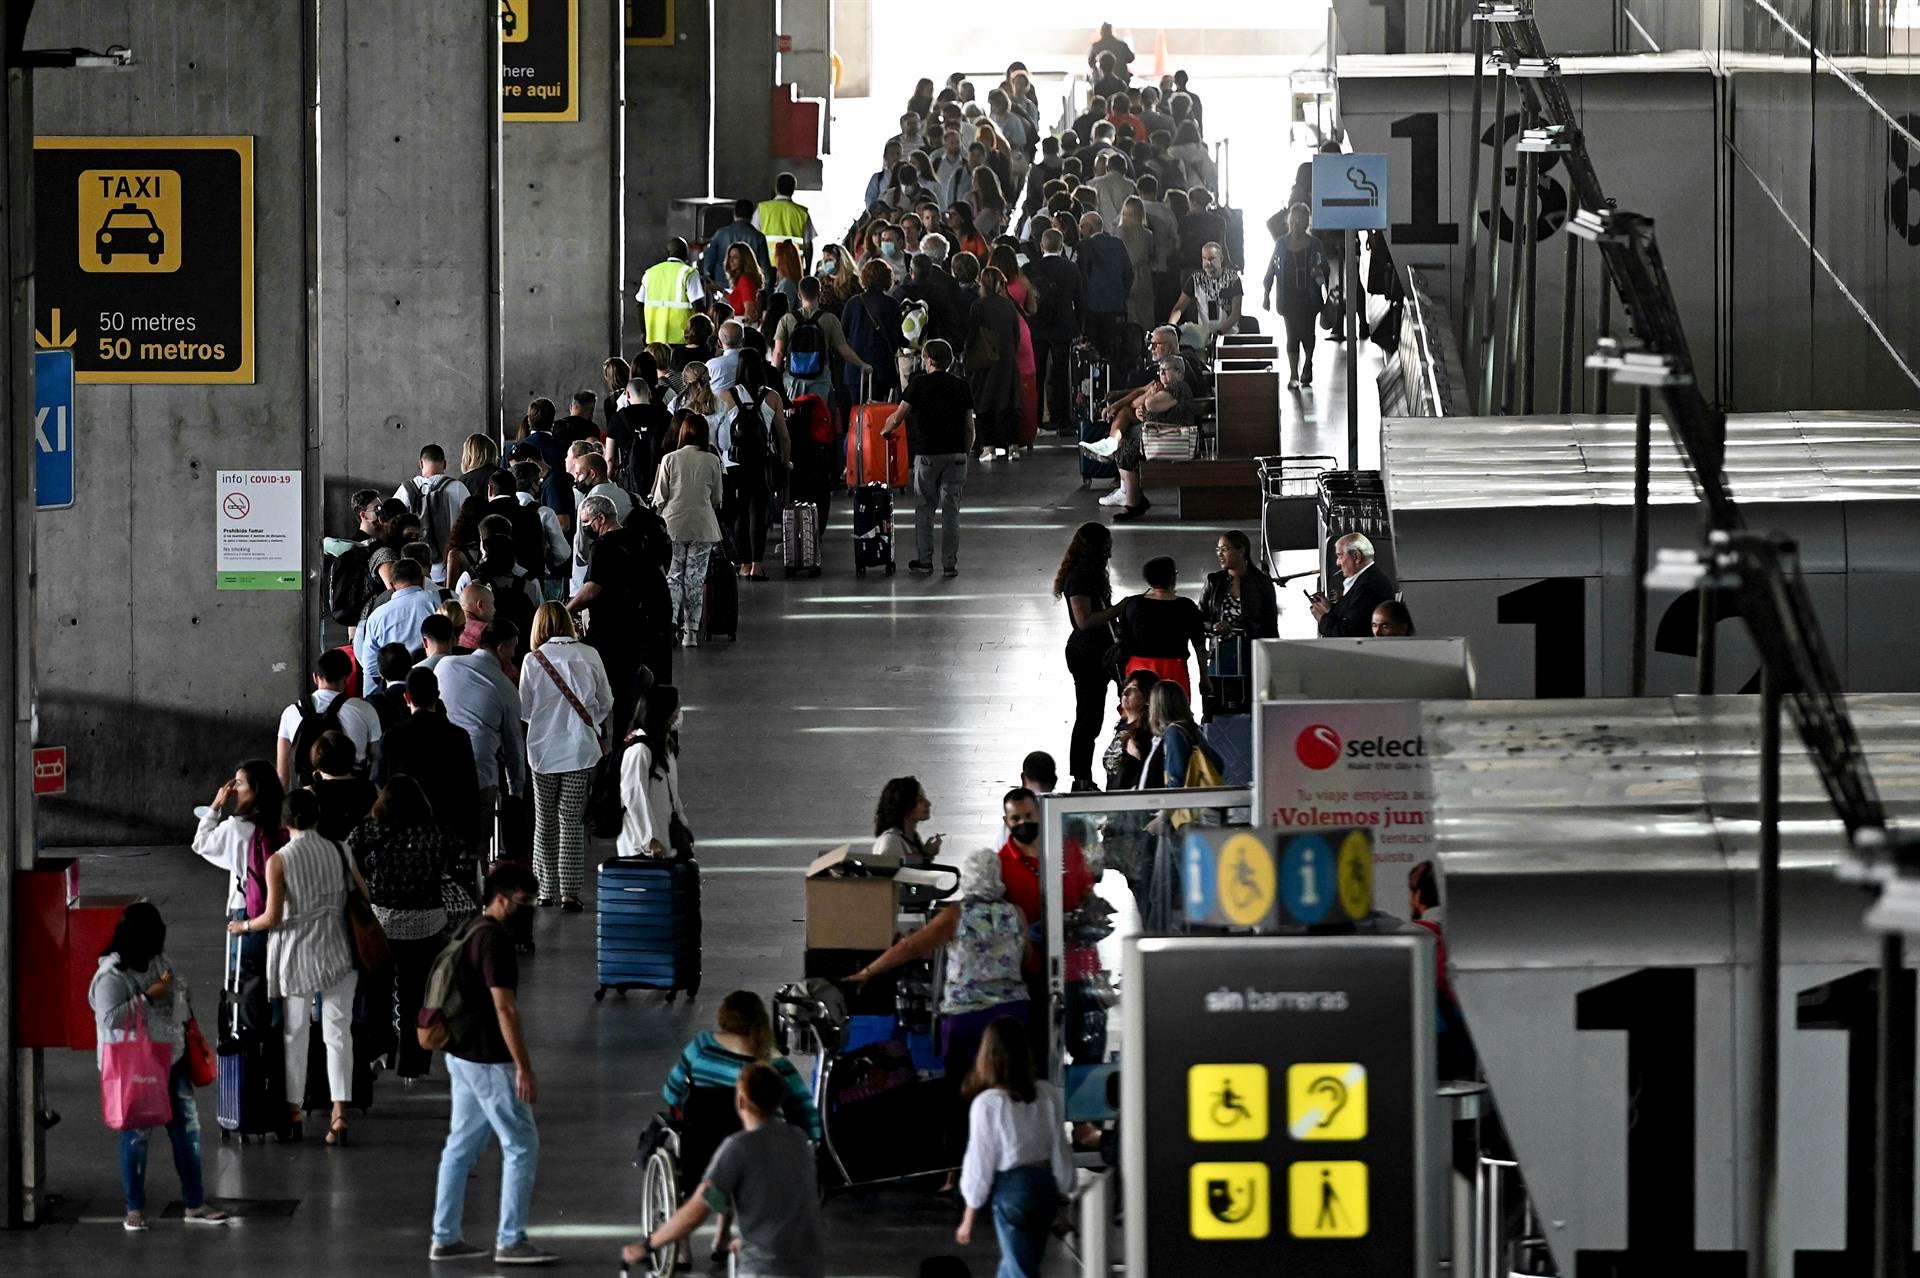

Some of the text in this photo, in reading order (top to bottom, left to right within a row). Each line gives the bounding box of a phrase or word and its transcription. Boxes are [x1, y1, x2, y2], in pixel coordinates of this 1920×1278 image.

[502, 85, 522, 96] re
[98, 176, 161, 198] TAXI
[99, 312, 196, 331] 50 metres
[99, 337, 226, 360] 50 metros
[222, 473, 291, 484] info COVID-19
[1353, 789, 1408, 803] empieza
[1272, 807, 1428, 828] ¡Volemos jun
[1205, 986, 1349, 1012] sin barreras
